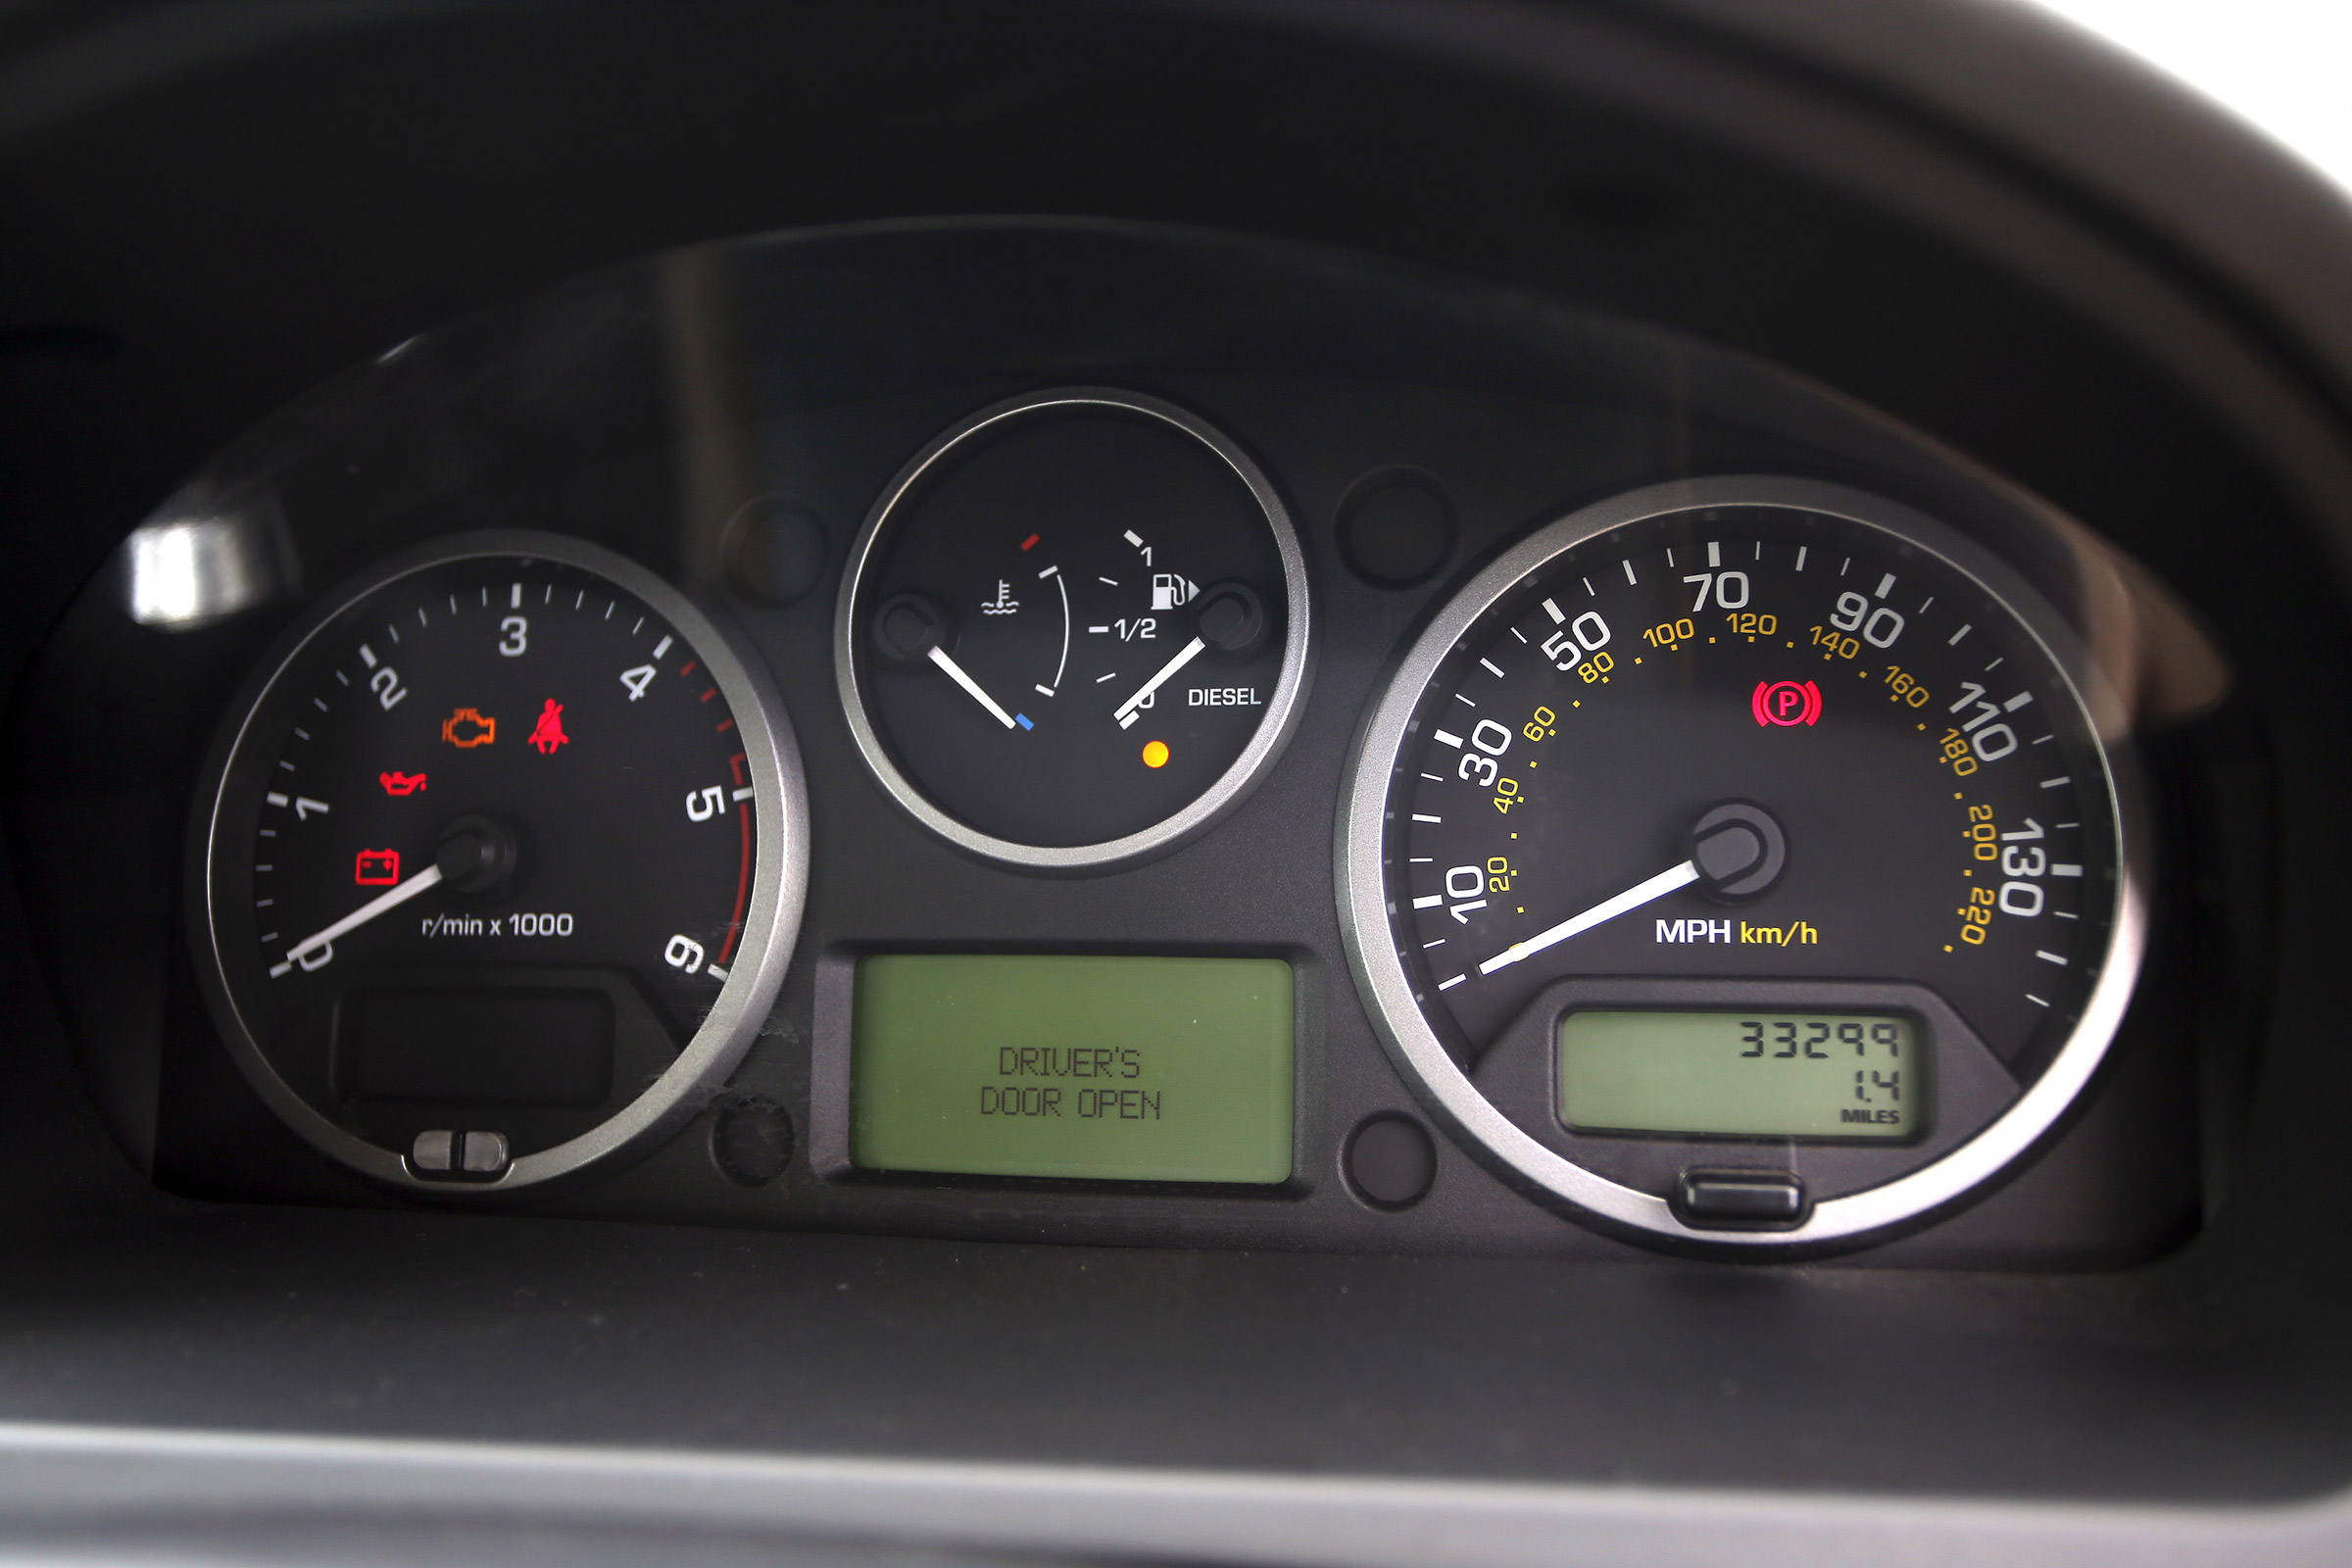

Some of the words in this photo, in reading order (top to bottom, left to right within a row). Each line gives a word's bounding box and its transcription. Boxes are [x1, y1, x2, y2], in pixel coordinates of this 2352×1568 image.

[1684, 570, 1749, 612] 70
[499, 616, 527, 656] 3
[1114, 617, 1156, 642] 1/2
[1642, 617, 1694, 648] 100
[1726, 612, 1778, 636] 120
[1830, 591, 1905, 649] 90
[1541, 611, 1612, 671] 50
[1809, 625, 1860, 660] 140
[619, 664, 657, 701] 4
[1577, 651, 1615, 684] 80
[370, 666, 407, 710] 2
[1188, 688, 1262, 707] DIESEL
[1779, 691, 1796, 716] P
[1883, 665, 1930, 709] 160
[1522, 706, 1556, 743] 60
[1949, 680, 2018, 761] 110
[1458, 718, 1512, 788] 30
[1939, 728, 1979, 777] 180
[295, 797, 329, 820] 1
[686, 786, 725, 821] 5
[1493, 777, 1519, 814] 40
[1969, 805, 1998, 861] 200
[1488, 857, 1510, 893] 20
[1999, 817, 2047, 917] 130
[1445, 864, 1488, 925] 10
[421, 913, 487, 938] r/min
[490, 919, 502, 936] x
[509, 913, 573, 937] 1000
[1655, 919, 1732, 944] MPH
[1740, 921, 1818, 945] km/h
[1961, 887, 1995, 946] 220
[664, 934, 705, 974] 6
[1740, 1021, 1899, 1058] 33299
[999, 1046, 1141, 1079] DRIVER'S
[980, 1086, 1062, 1118] DOOR
[1078, 1090, 1161, 1120] OPEN
[1855, 1069, 1900, 1103] 1.4
[1841, 1108, 1900, 1125] MILES
